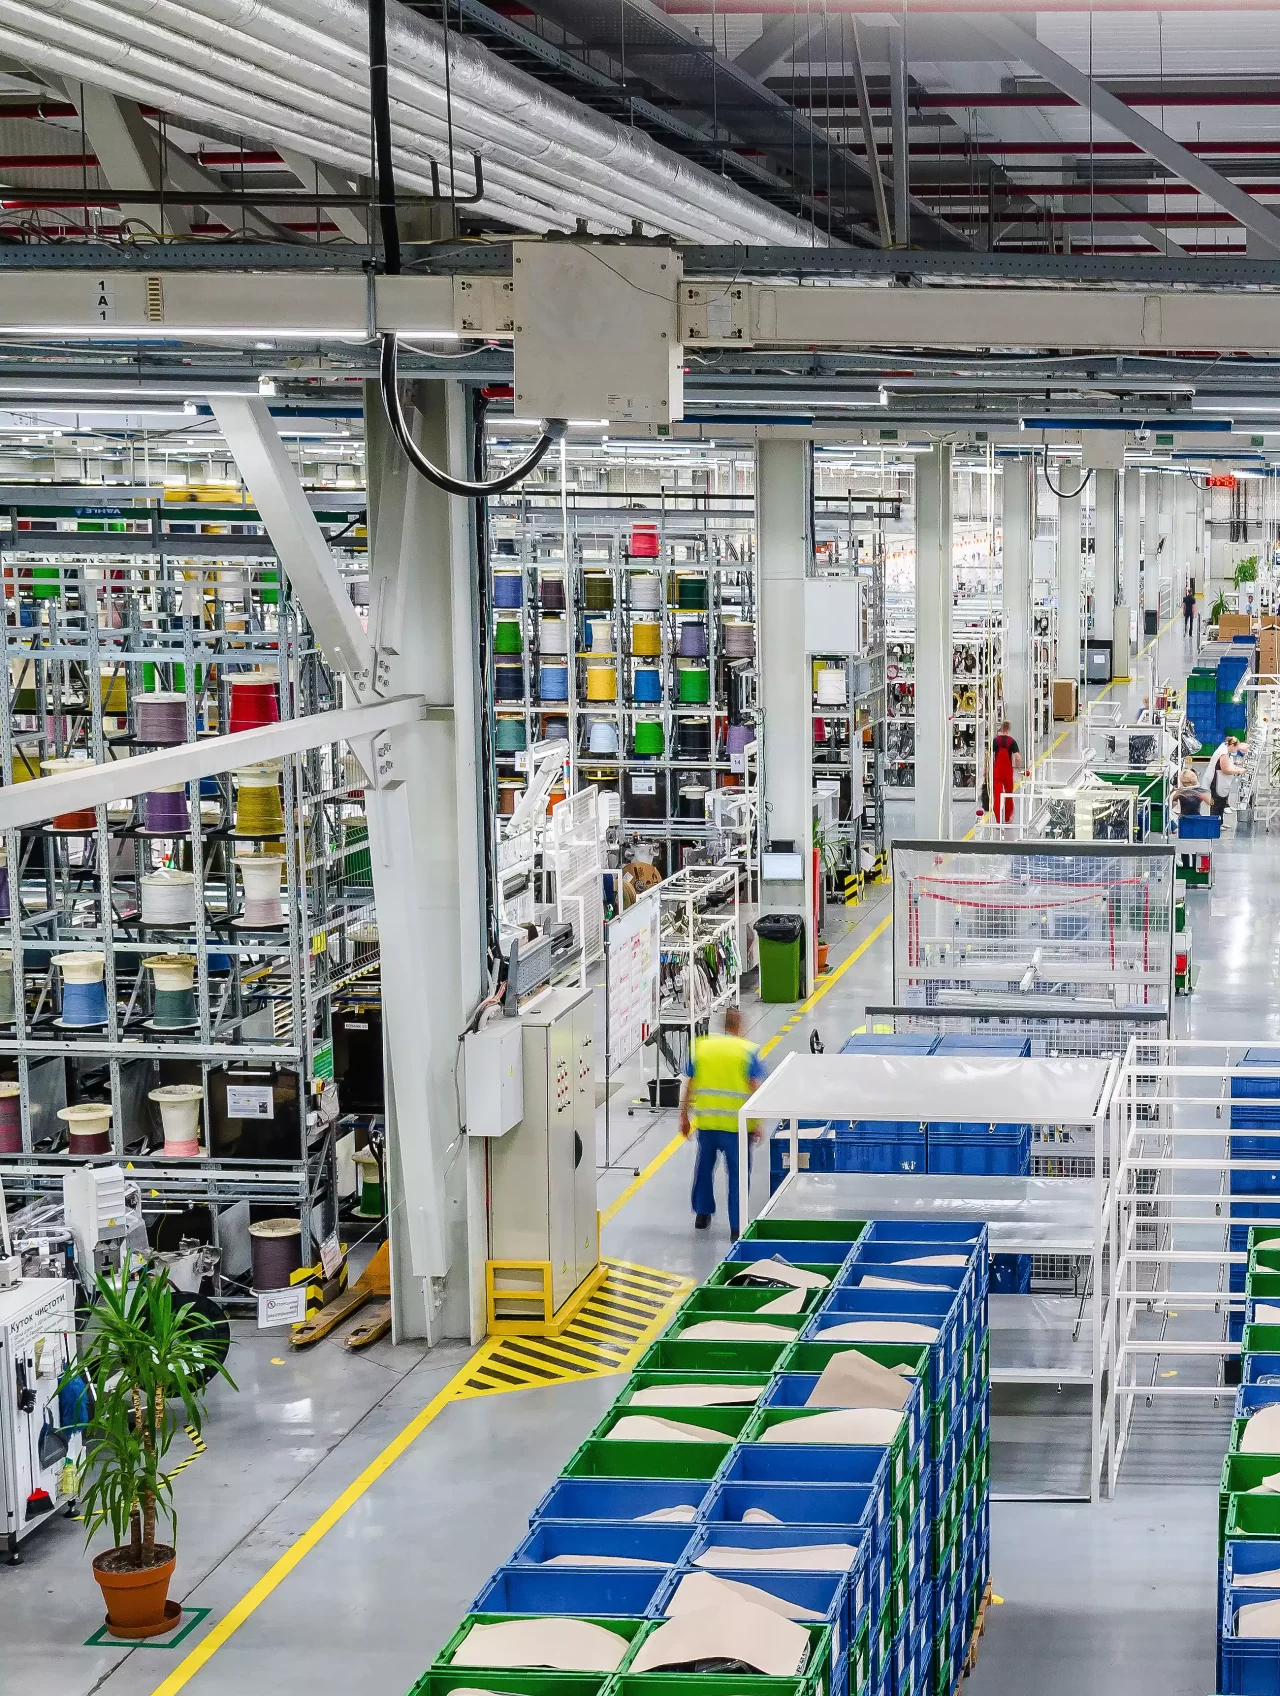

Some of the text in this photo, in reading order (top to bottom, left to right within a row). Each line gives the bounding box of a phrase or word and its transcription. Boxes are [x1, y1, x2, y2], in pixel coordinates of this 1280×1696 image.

[98, 280, 106, 291] 1
[97, 295, 109, 306] A
[99, 310, 106, 321] 1
[10, 1313, 34, 1334] Куток
[34, 1293, 66, 1317] чистоти
